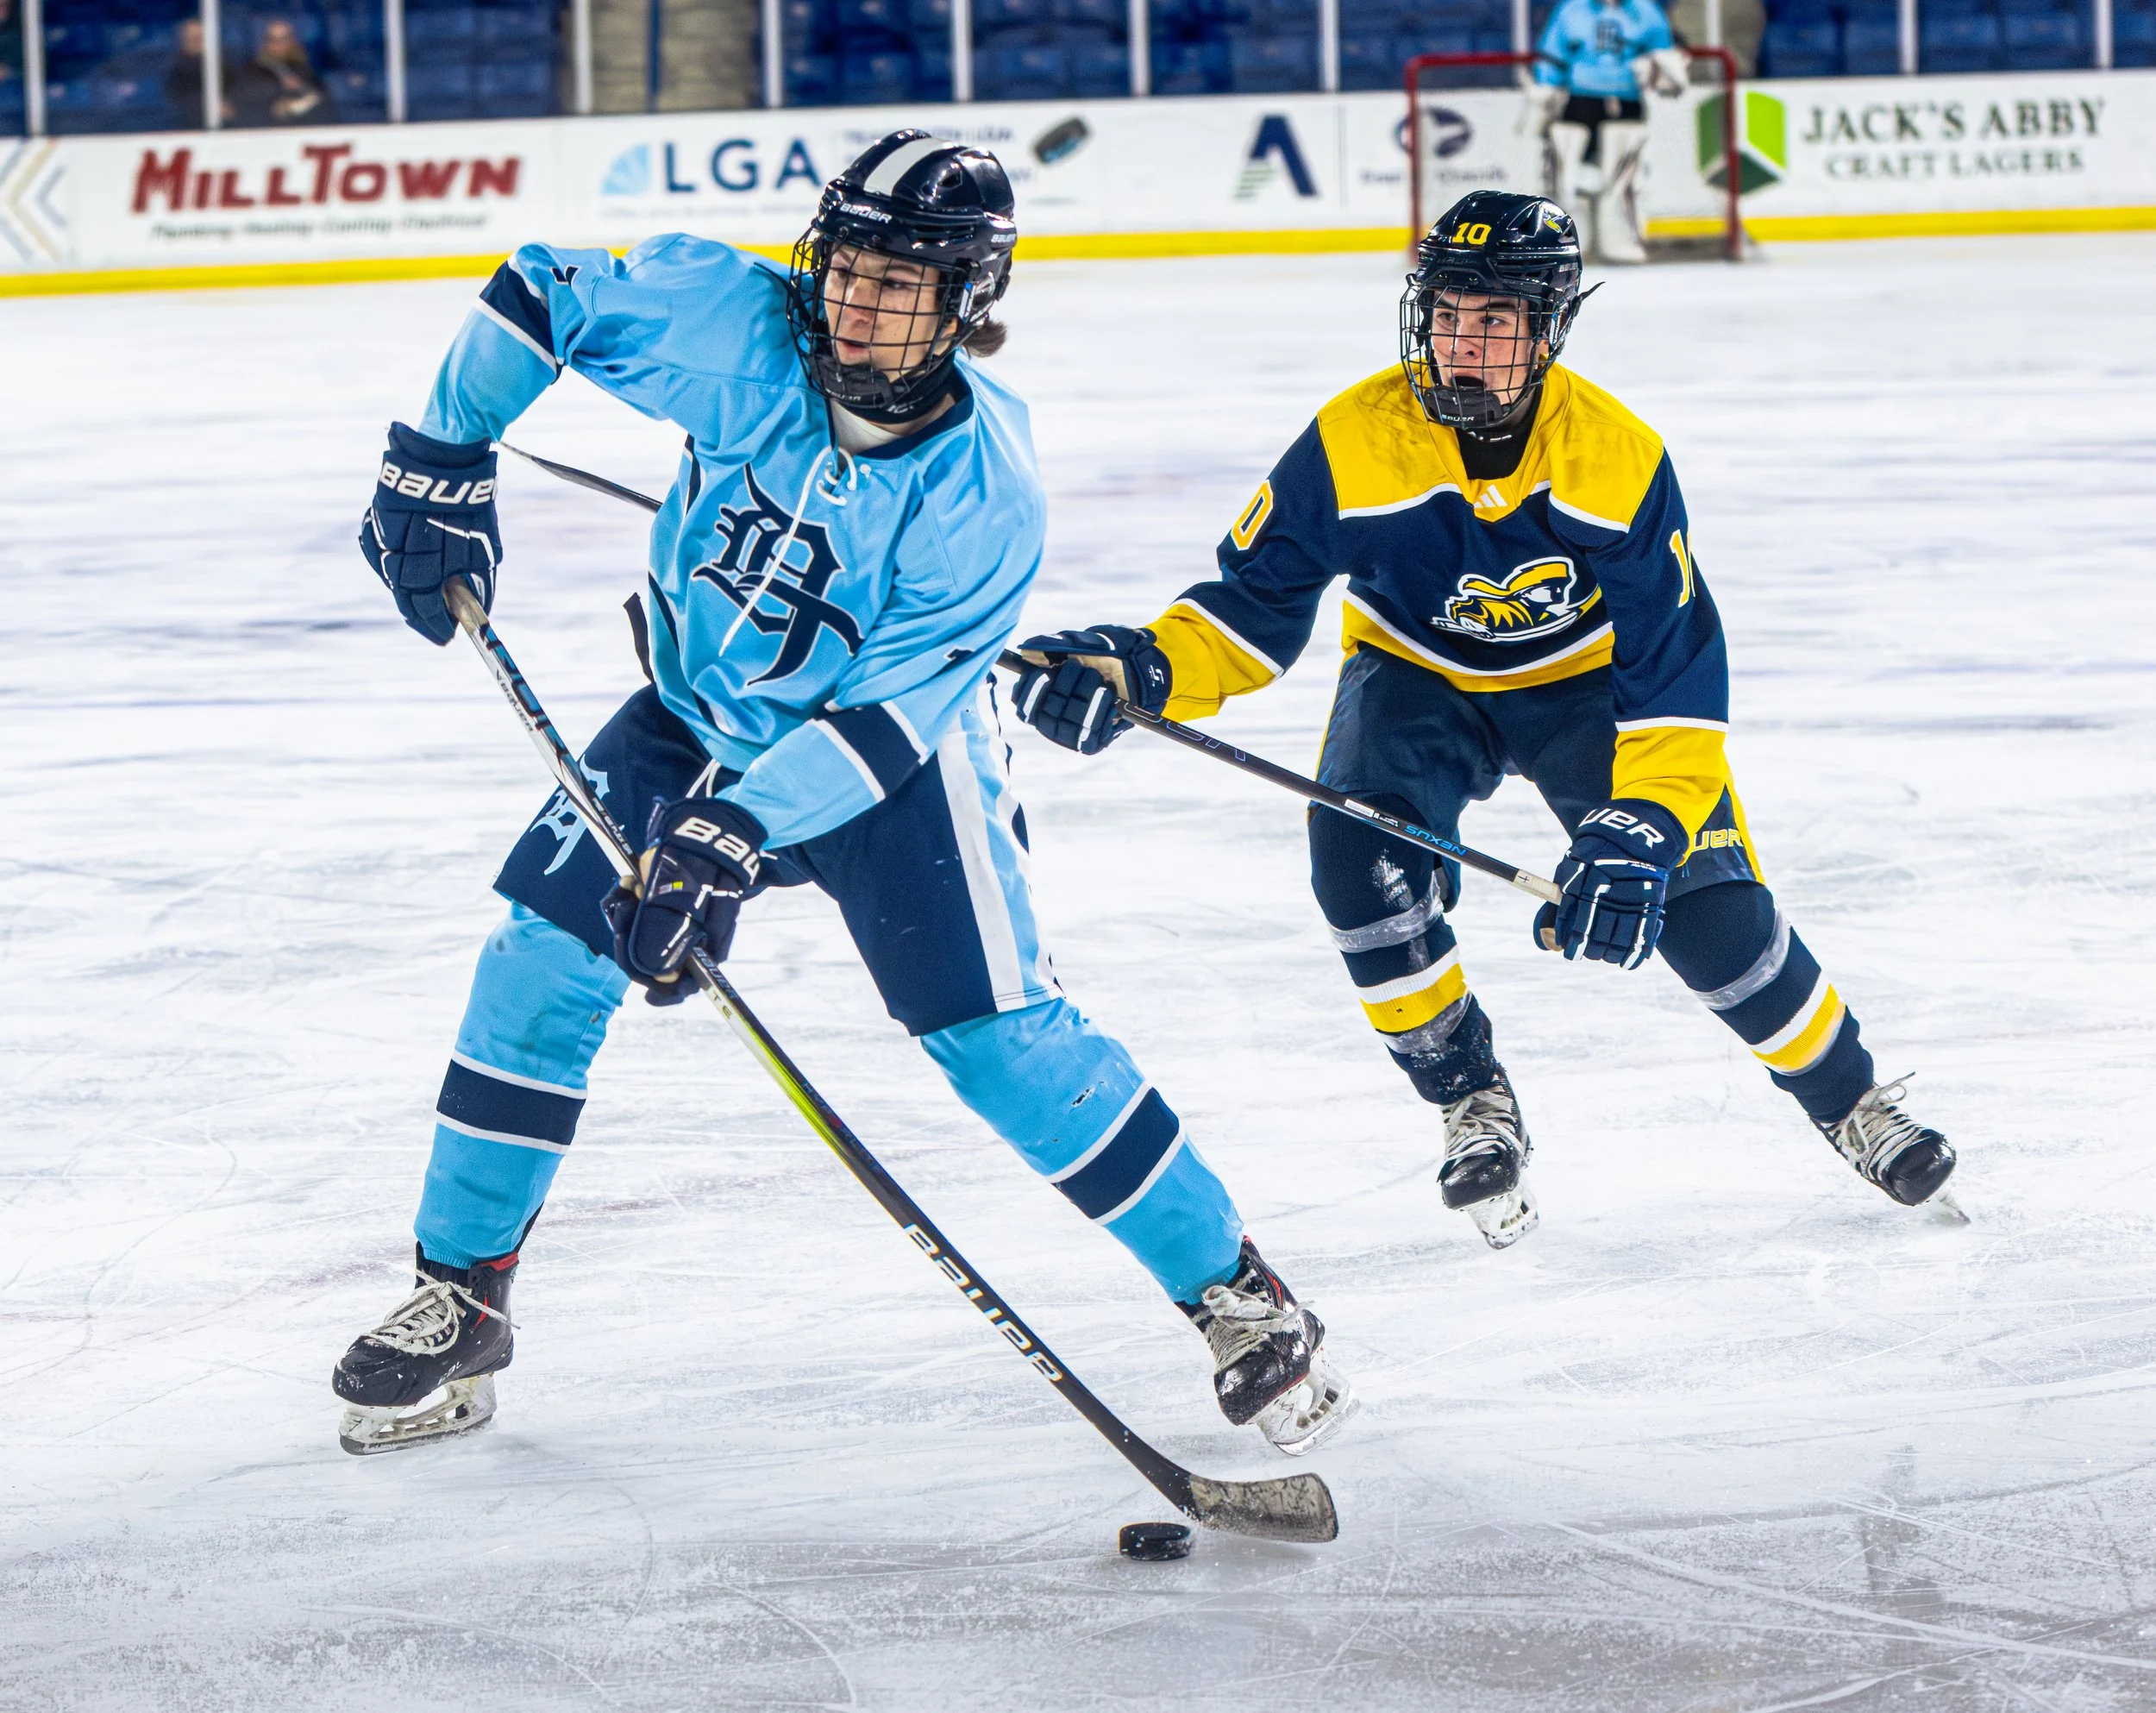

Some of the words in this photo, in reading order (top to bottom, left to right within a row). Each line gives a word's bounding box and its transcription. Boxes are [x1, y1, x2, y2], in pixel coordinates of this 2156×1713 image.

[1802, 99, 1966, 143] JACK'S
[1979, 96, 2105, 139] ABBY
[663, 138, 822, 193] LGA
[1825, 149, 1937, 180] CRAFT
[1451, 222, 1492, 246] 10
[379, 462, 498, 505] BAUE
[1404, 824, 1467, 856] NEXUS
